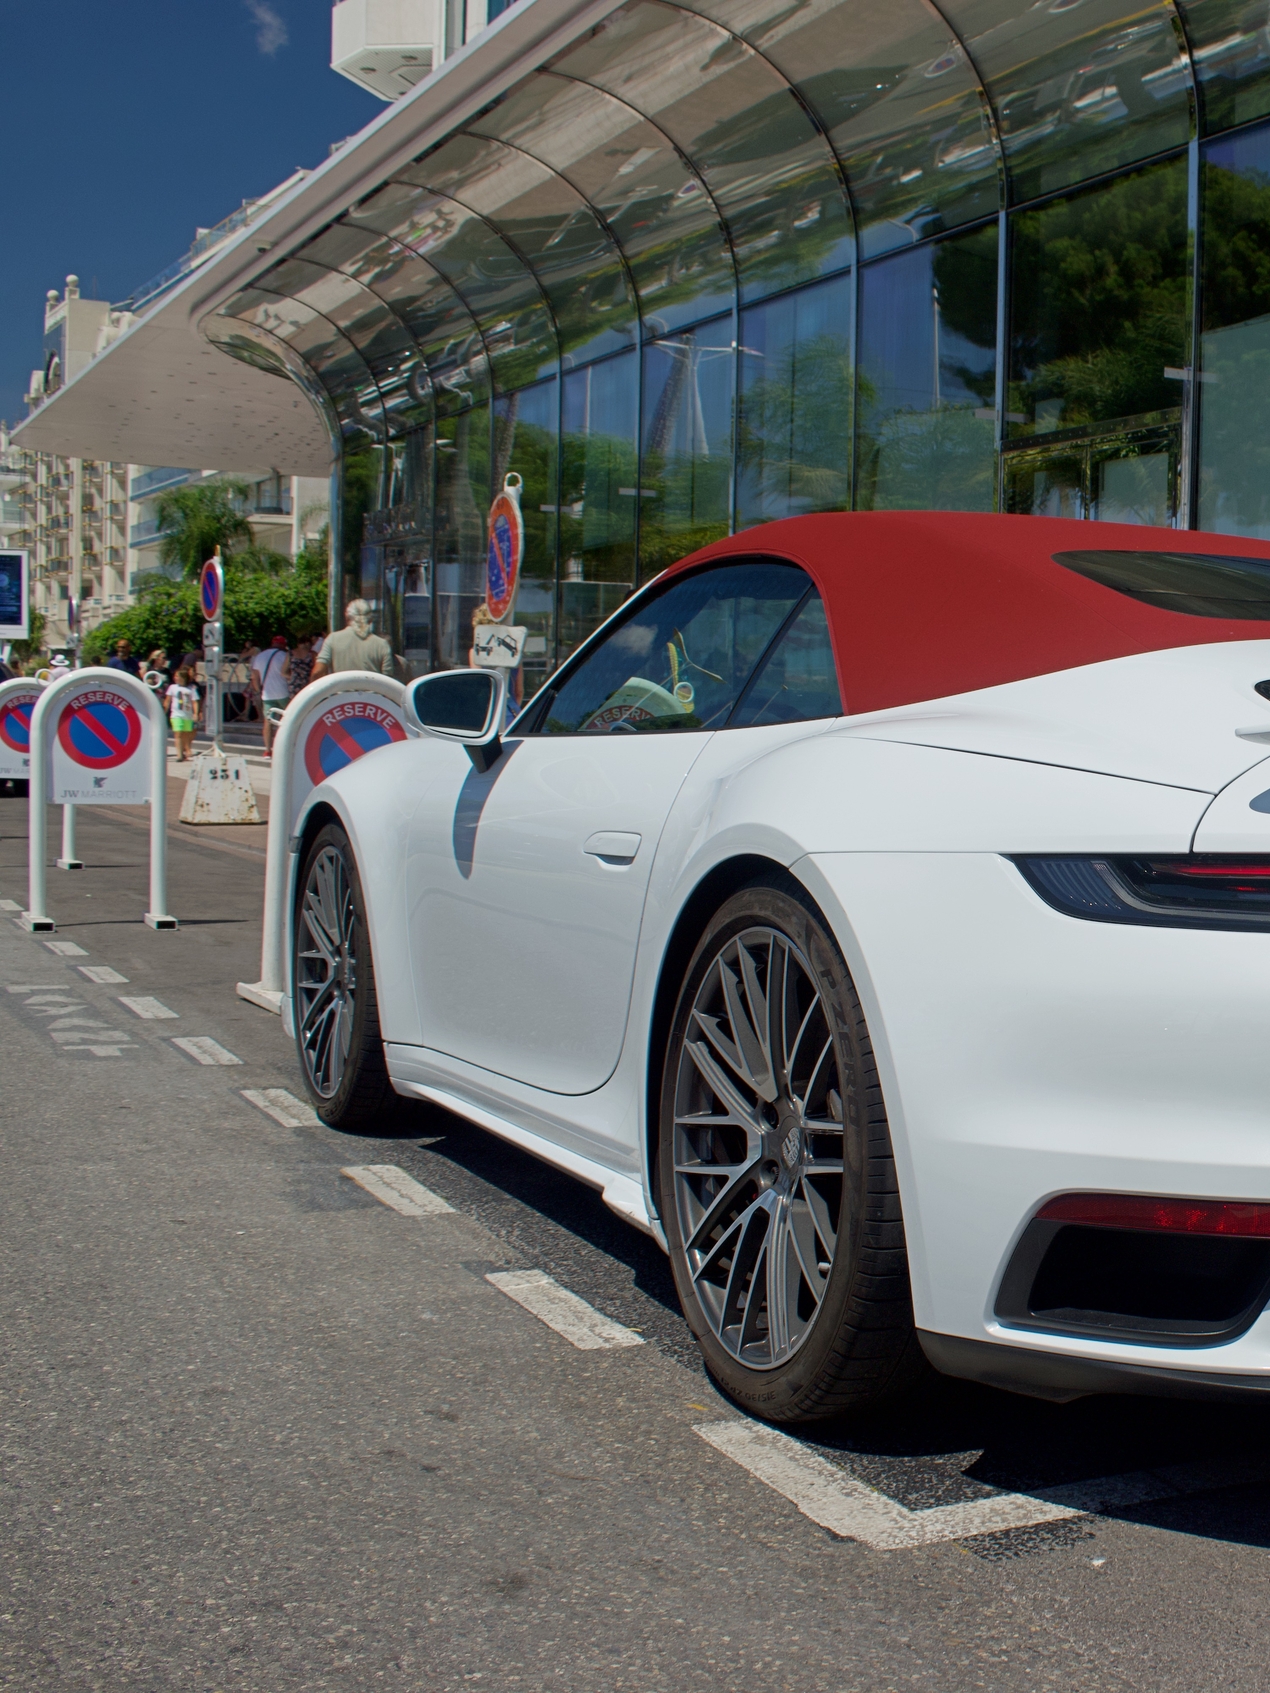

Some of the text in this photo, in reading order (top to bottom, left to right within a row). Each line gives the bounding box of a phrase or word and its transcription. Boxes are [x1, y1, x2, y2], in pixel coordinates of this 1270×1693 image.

[70, 691, 130, 711] RESERVE
[322, 703, 396, 729] RESERVE
[60, 790, 137, 799] JW MARRIOTT
